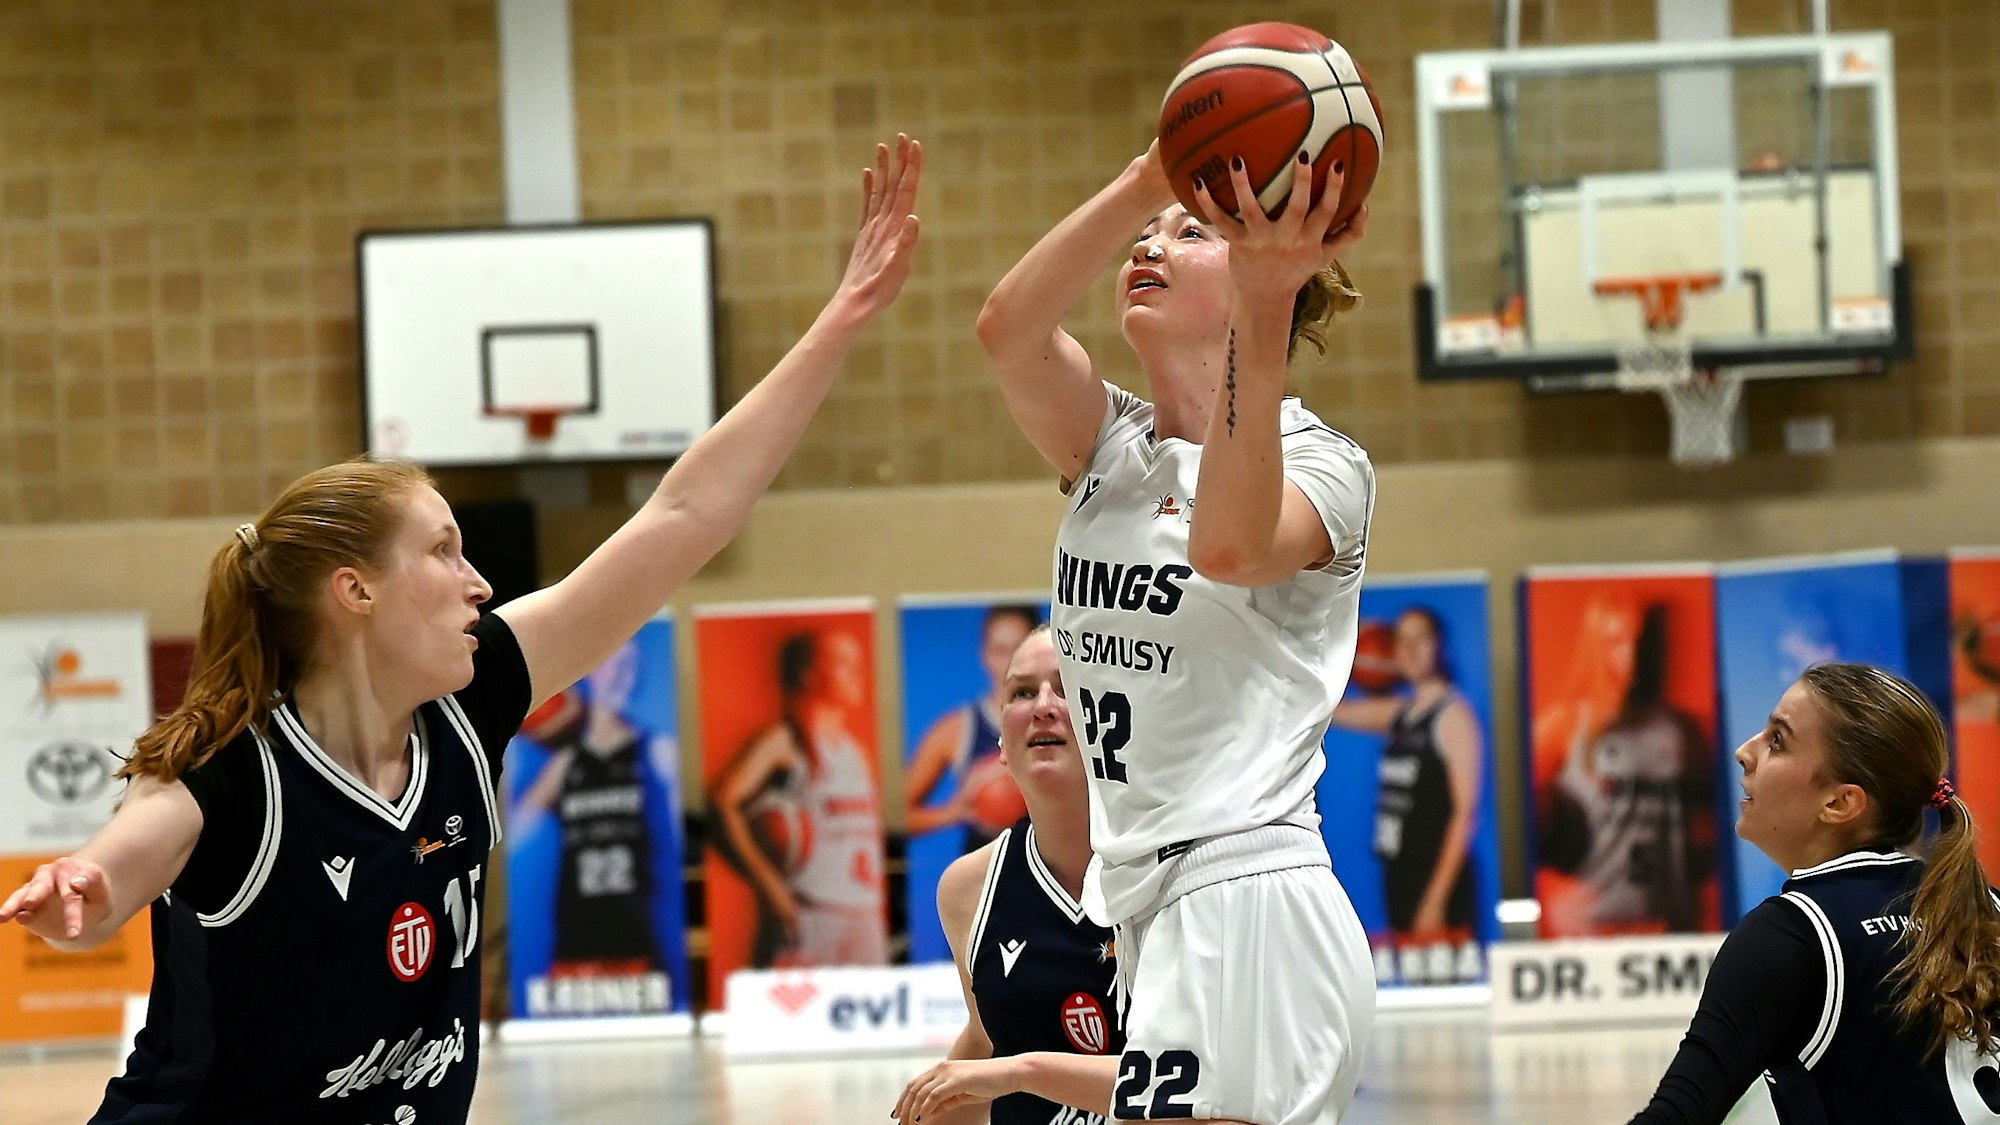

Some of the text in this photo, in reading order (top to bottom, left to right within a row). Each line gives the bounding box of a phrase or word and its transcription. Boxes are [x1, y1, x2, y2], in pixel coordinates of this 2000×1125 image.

[1057, 546, 1194, 616] WINGS
[1081, 632, 1175, 675] SMUSY
[1861, 915, 1899, 936] ETV
[1510, 956, 1602, 1005] DR.
[1616, 948, 1712, 1000] SM
[829, 983, 910, 1032] evl
[319, 1017, 465, 1099] Kellogg's
[1114, 1050, 1200, 1119] 22
